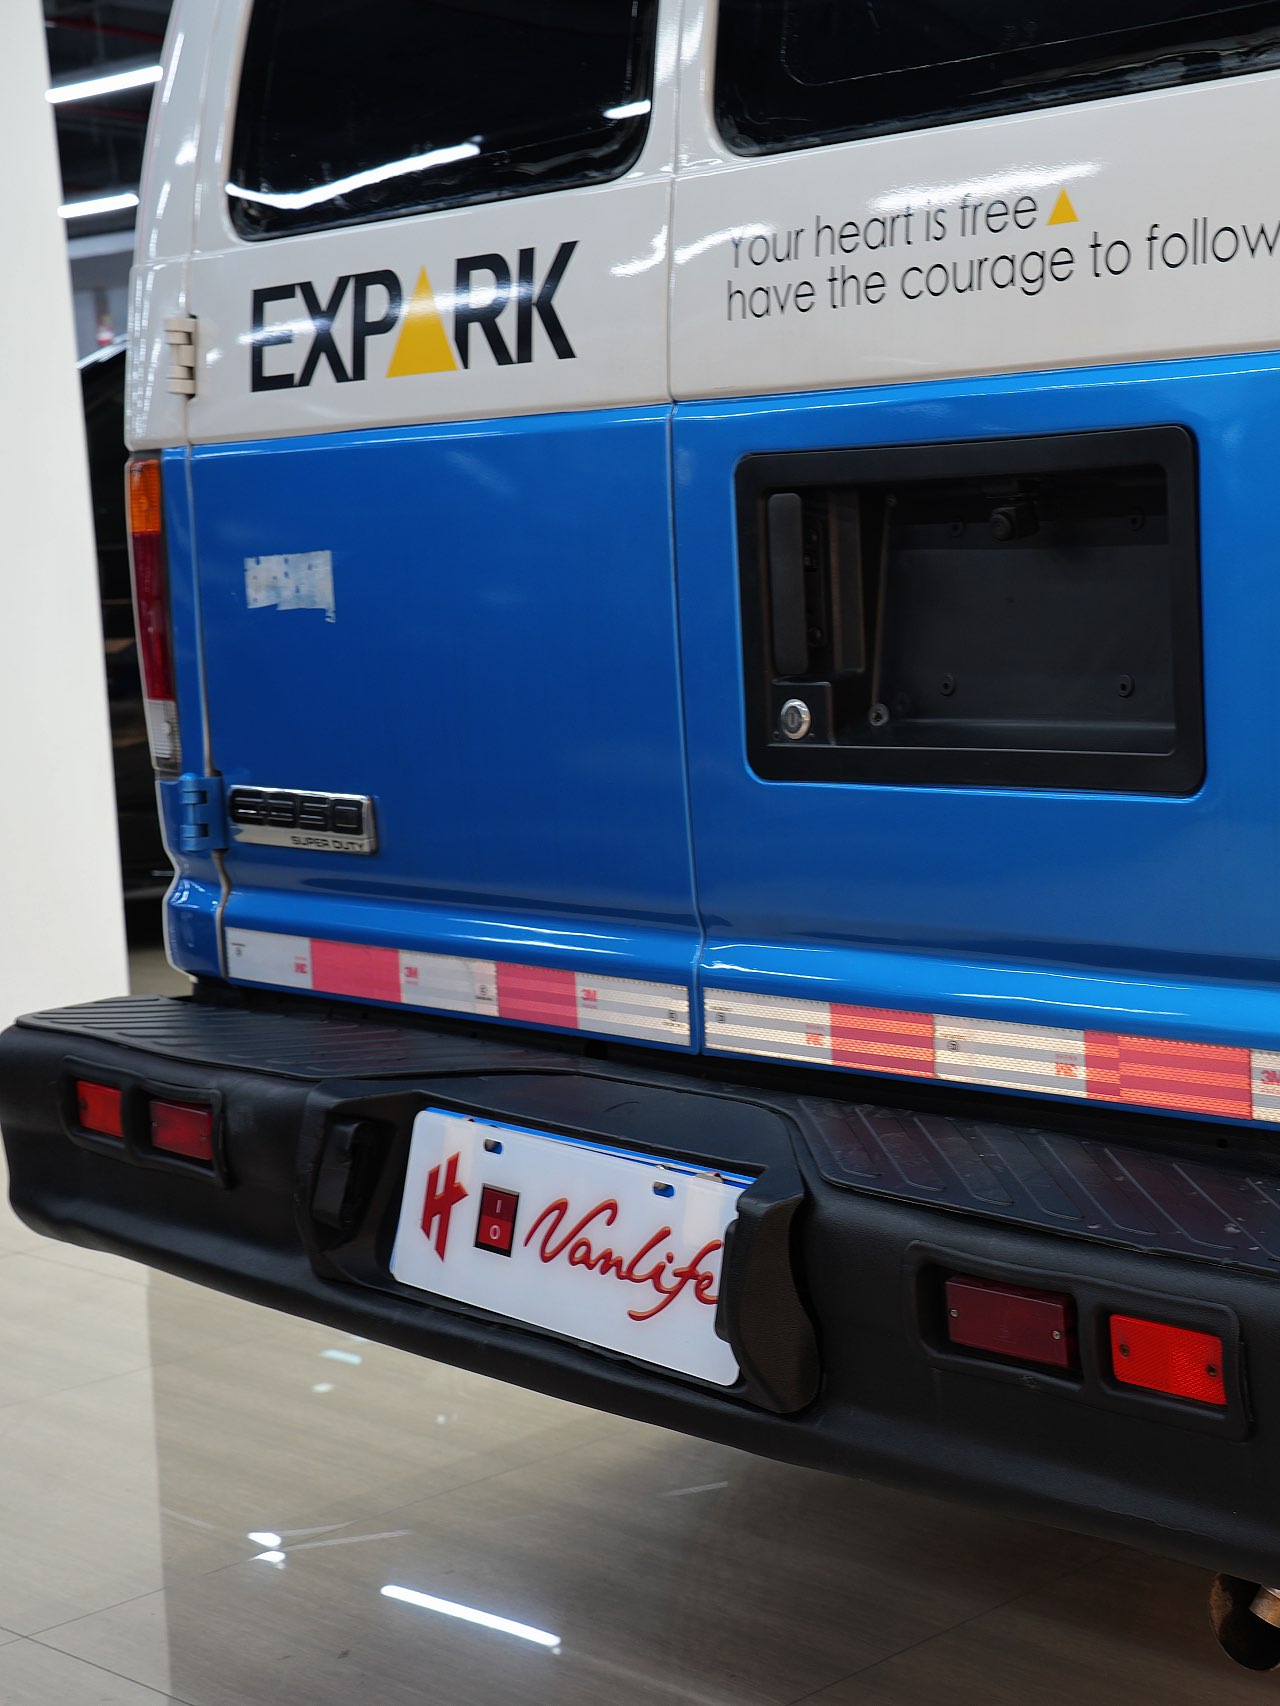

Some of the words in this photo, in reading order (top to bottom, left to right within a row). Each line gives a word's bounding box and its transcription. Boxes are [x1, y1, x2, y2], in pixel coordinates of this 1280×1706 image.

[731, 228, 805, 268] Your
[815, 206, 914, 258] heart
[925, 199, 947, 242] is
[959, 192, 1038, 238] free
[250, 240, 579, 392] EXPARK
[727, 279, 816, 321] have
[828, 264, 886, 309] the
[900, 246, 1075, 297] courage
[1089, 231, 1131, 278] to
[291, 835, 329, 849] SUPER
[332, 840, 365, 851] DUTY
